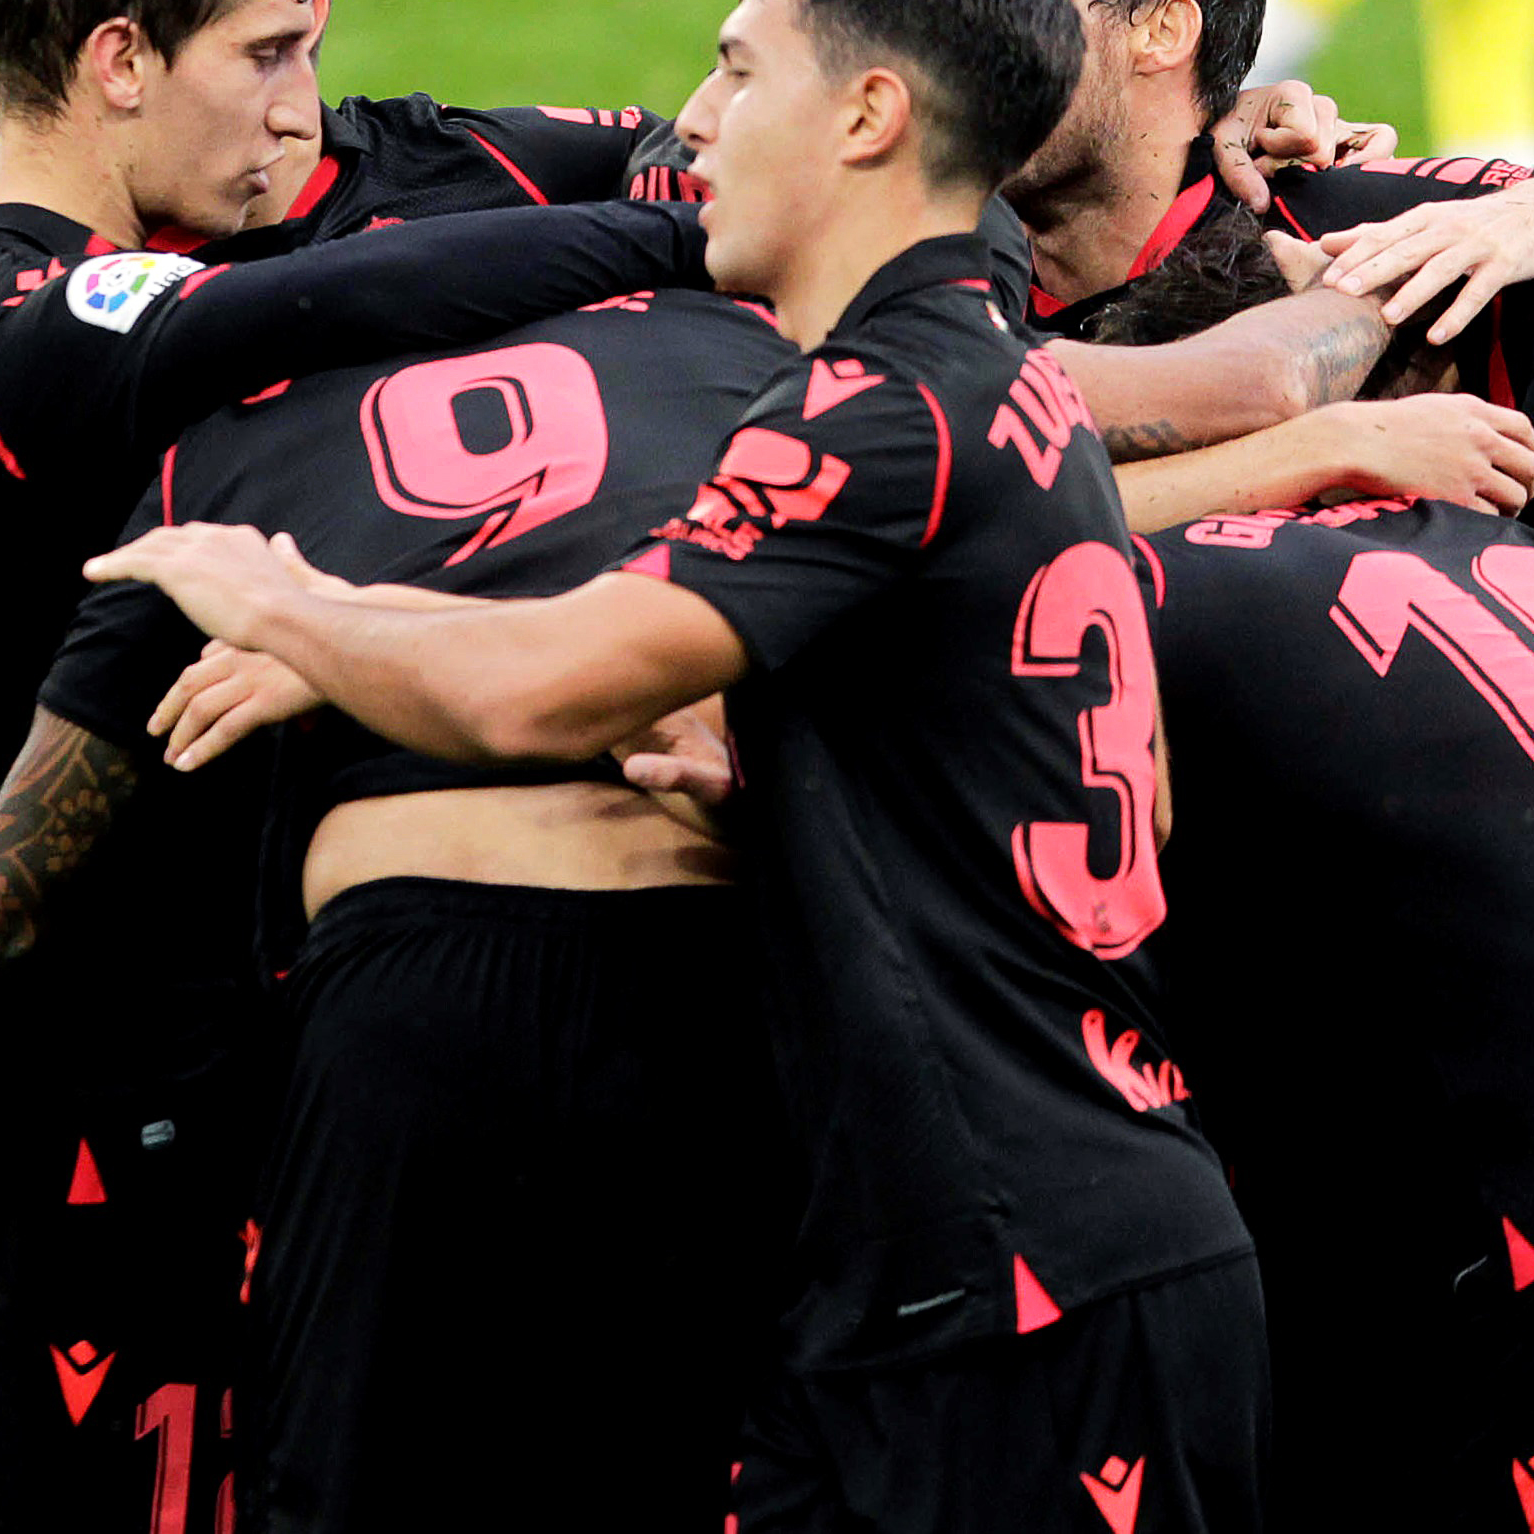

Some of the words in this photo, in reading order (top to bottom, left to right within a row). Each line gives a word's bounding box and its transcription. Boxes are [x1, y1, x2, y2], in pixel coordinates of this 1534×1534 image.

[359, 342, 608, 567] 9
[1012, 540, 1168, 961] 3
[133, 1382, 237, 1534] 1
